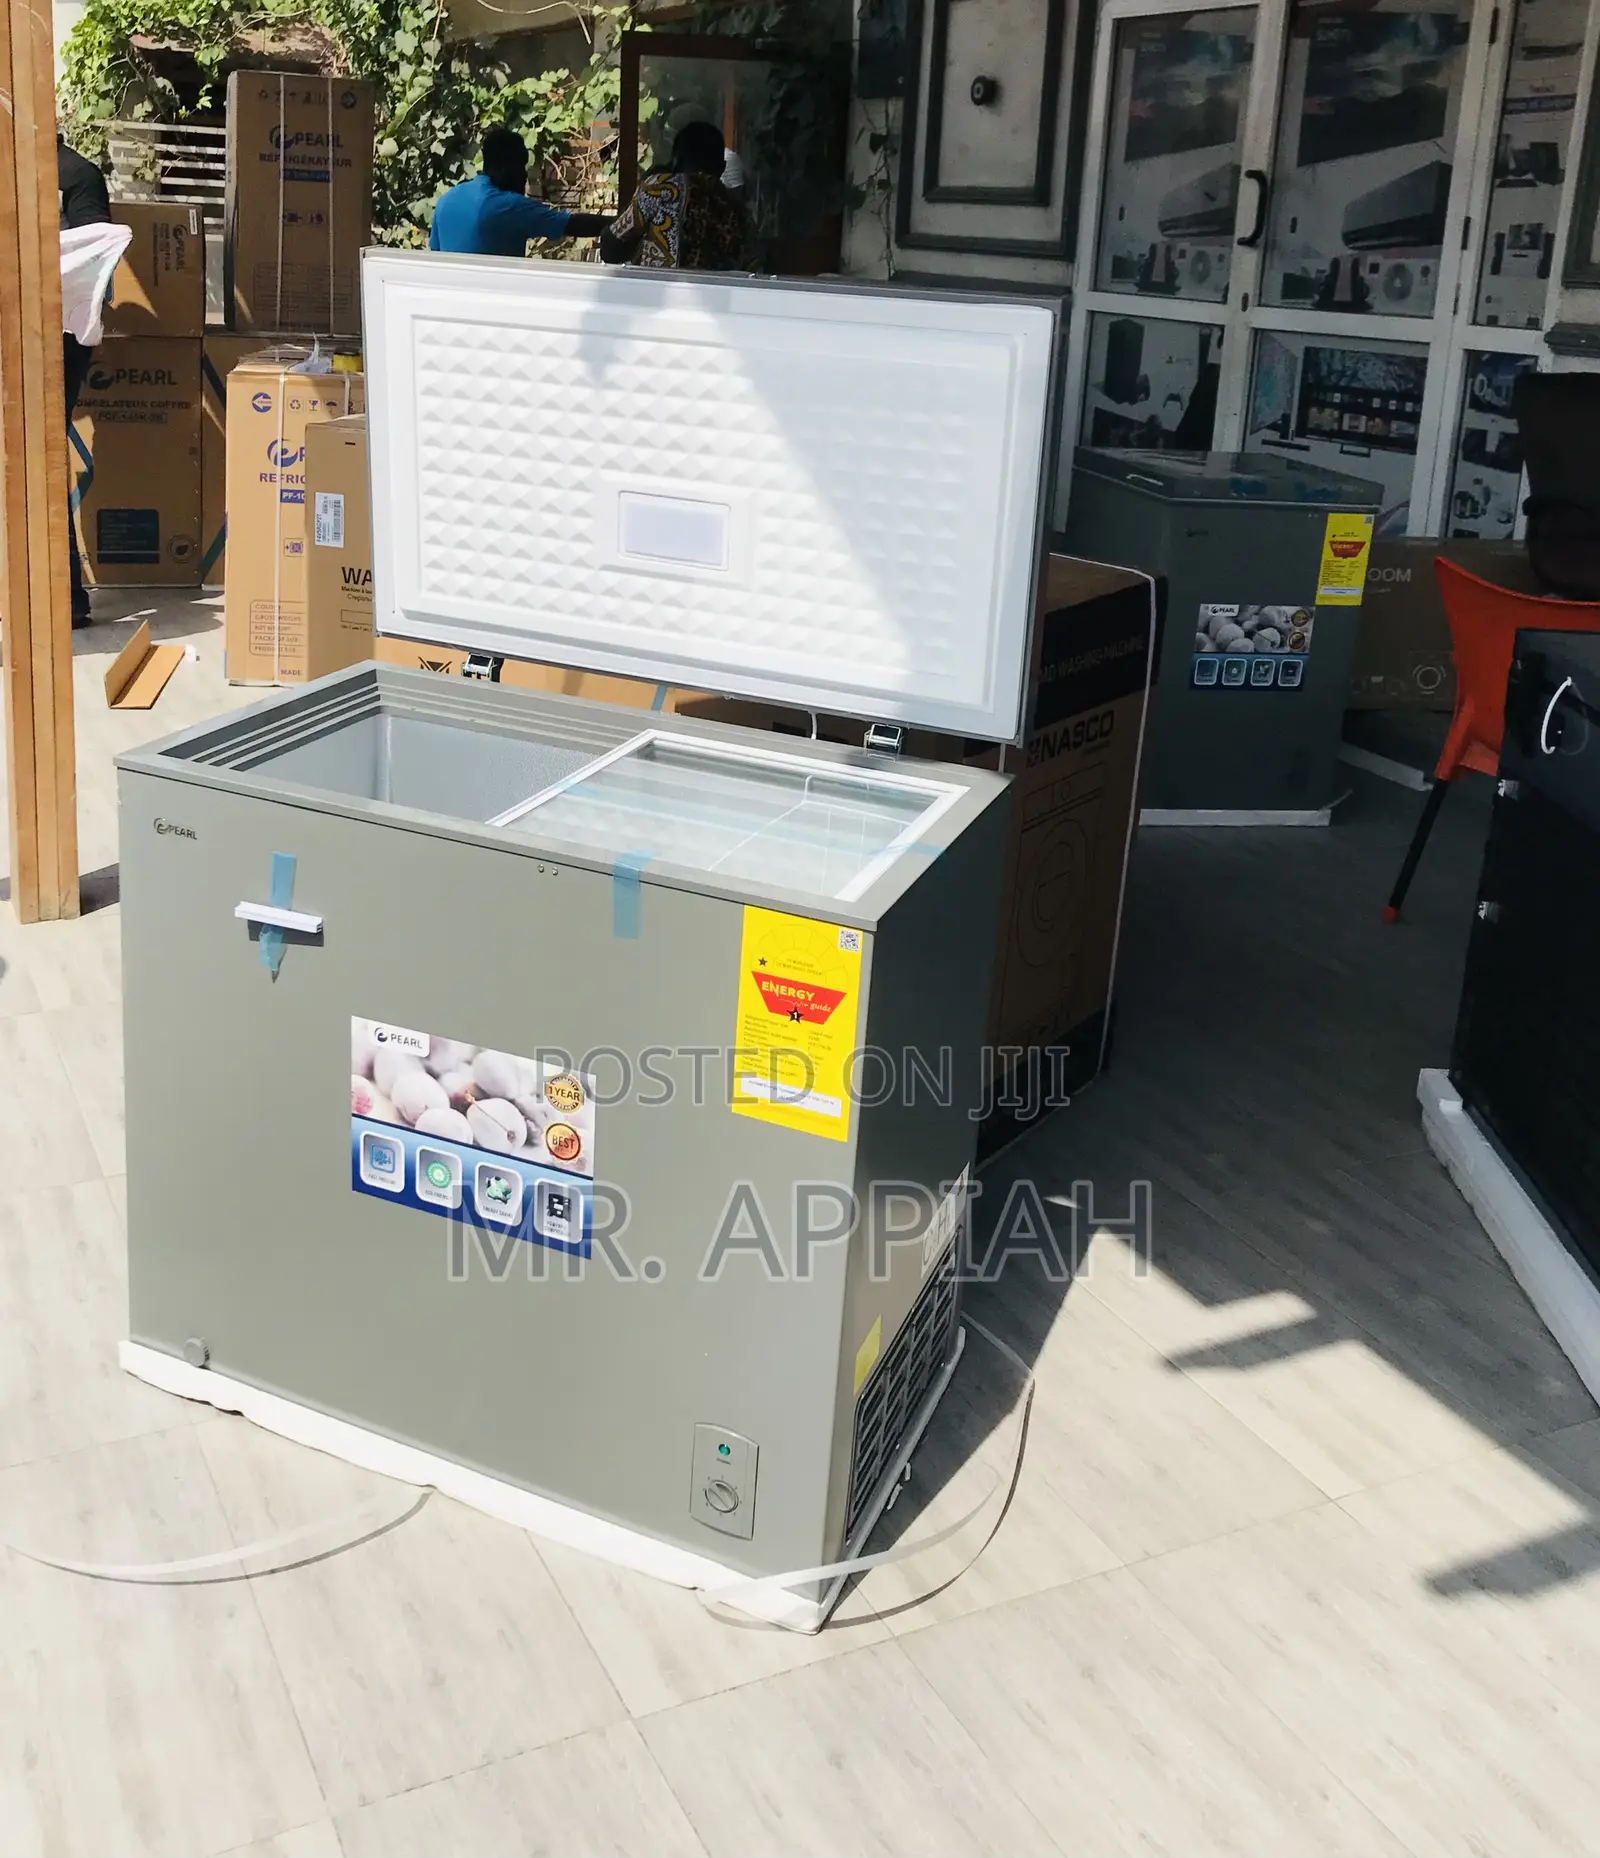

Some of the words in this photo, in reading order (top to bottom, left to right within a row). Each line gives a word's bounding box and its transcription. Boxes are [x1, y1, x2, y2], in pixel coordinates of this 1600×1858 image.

[295, 132, 344, 149] PEARL
[116, 368, 178, 386] PEARL
[341, 566, 373, 586] WA
[1040, 709, 1115, 763] NASCO
[167, 823, 198, 841] PEARL
[761, 980, 816, 1002] ENERGY
[793, 1011, 798, 1020] 1
[809, 1002, 833, 1013] guide
[390, 1032, 423, 1050] PEARL
[548, 1086, 553, 1096] 1
[554, 1086, 581, 1102] YEAR
[552, 1134, 576, 1150] BEST
